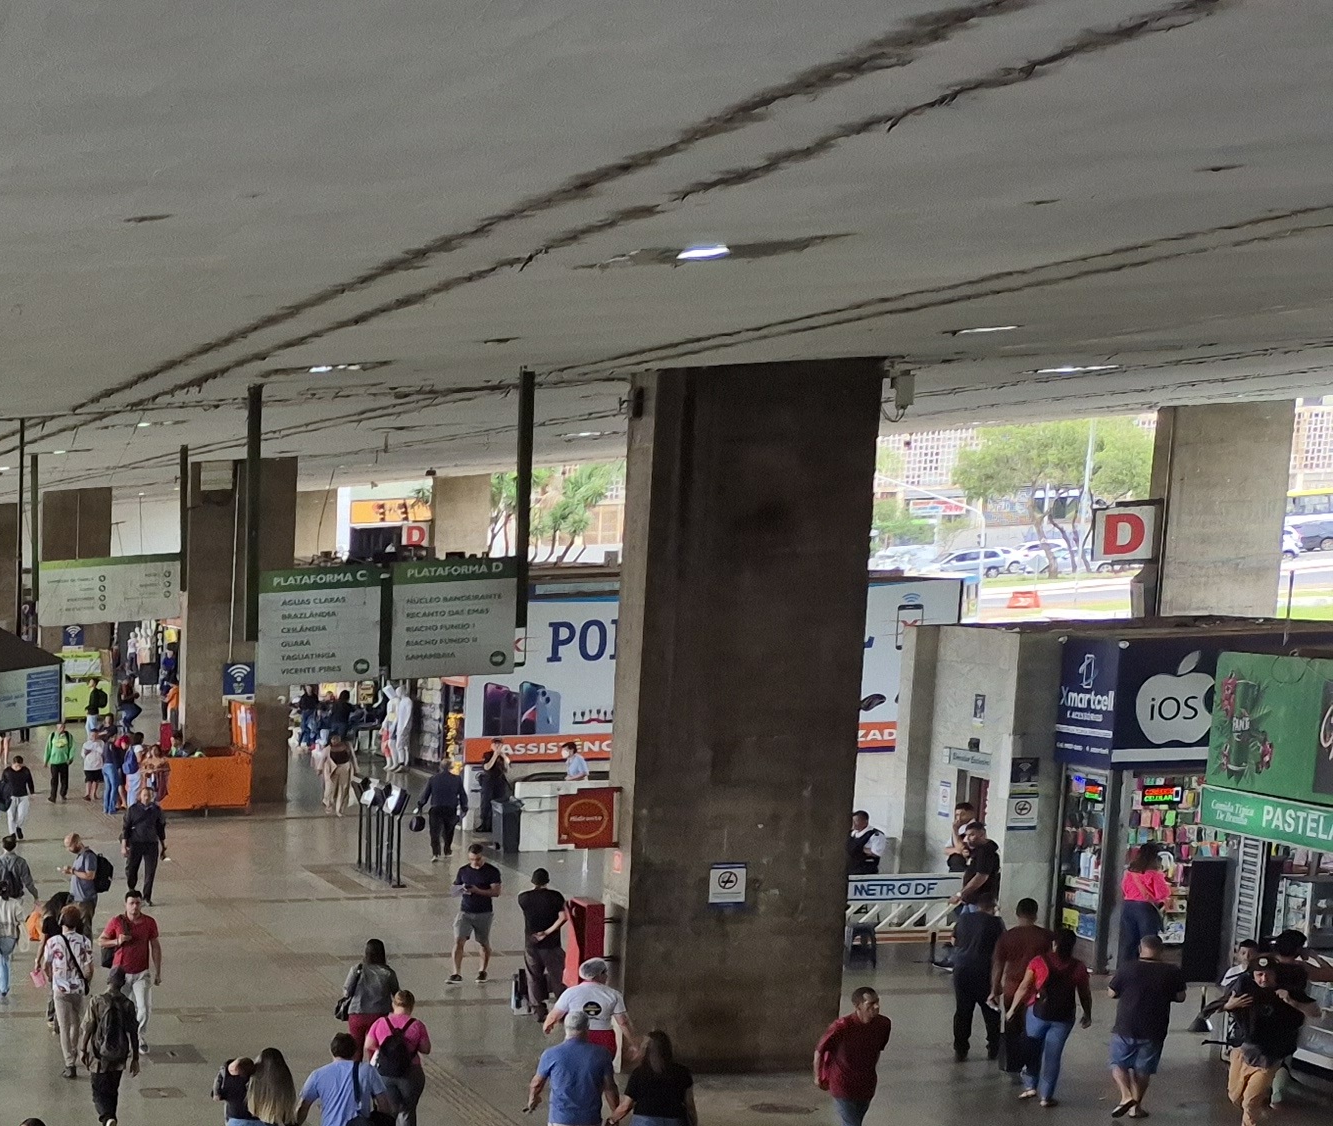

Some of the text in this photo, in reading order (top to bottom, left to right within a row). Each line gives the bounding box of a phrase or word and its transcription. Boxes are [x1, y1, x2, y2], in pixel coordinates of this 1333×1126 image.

[406, 525, 425, 546] D
[1104, 514, 1145, 555] D
[273, 570, 367, 586] PLATAFORMA C
[407, 562, 503, 578] PLATAFORMA D
[1149, 696, 1199, 720] iOS
[1262, 805, 1333, 841] PASTEL
[914, 882, 937, 896] DF
